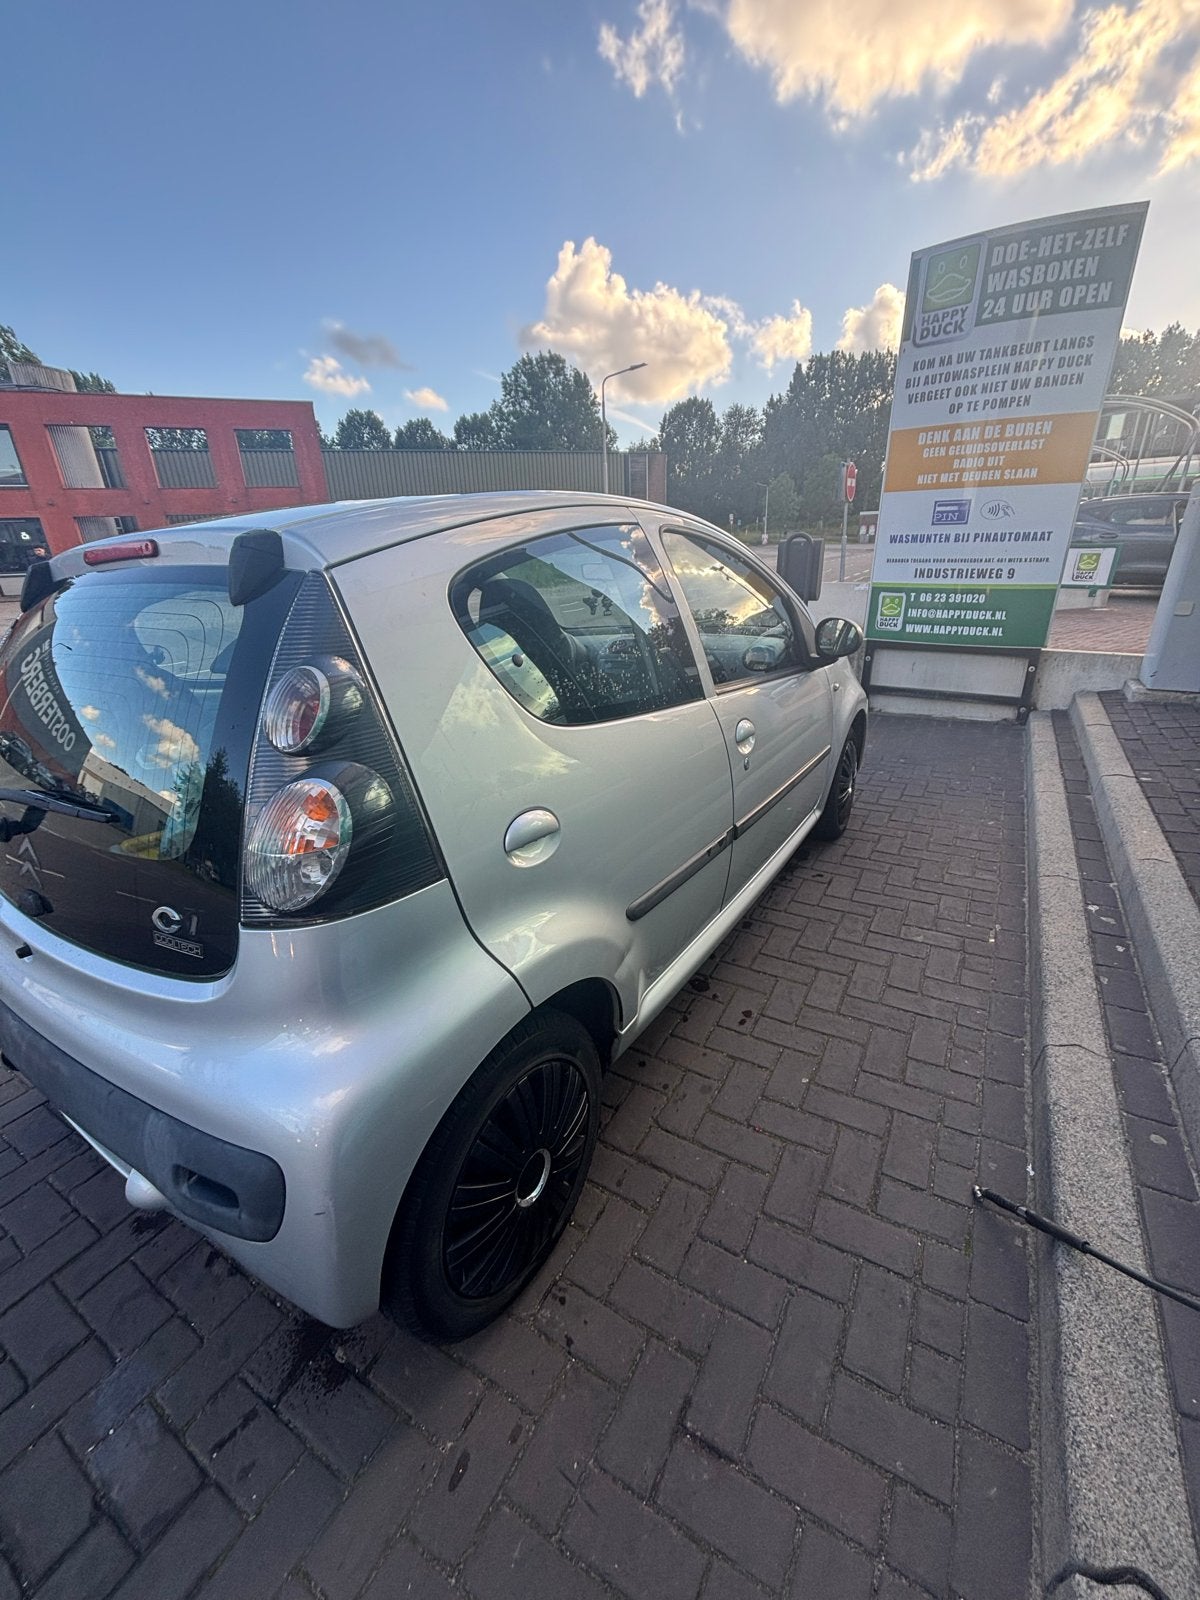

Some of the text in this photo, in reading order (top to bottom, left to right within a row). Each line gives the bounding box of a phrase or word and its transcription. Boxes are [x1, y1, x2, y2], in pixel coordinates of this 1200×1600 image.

[990, 224, 1129, 267] DOE-HET-ZELF
[986, 256, 1100, 293] WASBOXEN
[981, 281, 1113, 320] 24 UUR OPEN
[921, 306, 969, 327] HAPPY
[919, 319, 965, 341] DUCK
[913, 335, 1095, 372] KOM NA UW TANKBEURT LANGS
[905, 353, 1094, 389] BIJ AUTOWASPLEIN HAPPY DUCK
[907, 372, 1084, 404] VERGEET OOK NIET UW BANDEN
[949, 395, 1032, 414] OP TE POMPEN
[918, 421, 1053, 446] DENK AAN DE BUREN
[923, 438, 1045, 458] GEEN GELUIDSOVERLAST
[953, 455, 1006, 469] RADIO UIT
[917, 468, 1038, 485] NIET MET DEUREN SLAAN
[934, 512, 959, 522] PIN
[889, 531, 1053, 544] WASMUNTEN BIJ PINAUTOMAAT
[914, 568, 1015, 579] INDUSTRIEWEG 9
[910, 592, 986, 603] T 06 23 391020
[907, 608, 1006, 620] INFO@HAPPYDUCK.NL
[905, 623, 1003, 636] WWW.HAPPYDUCK.NL
[152, 906, 198, 935] C1
